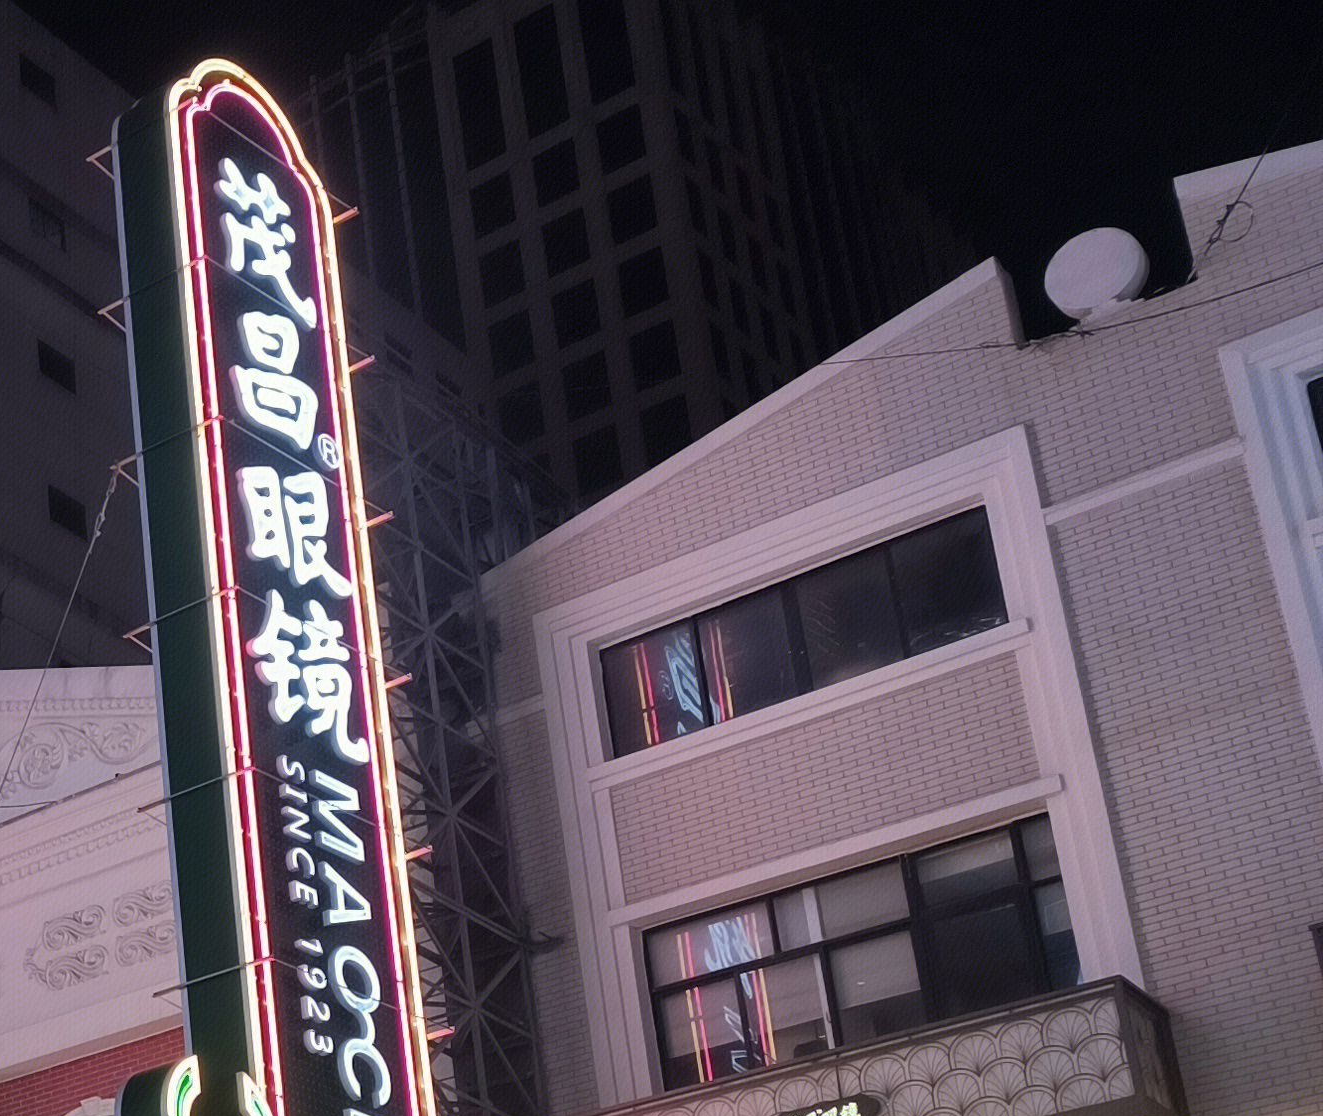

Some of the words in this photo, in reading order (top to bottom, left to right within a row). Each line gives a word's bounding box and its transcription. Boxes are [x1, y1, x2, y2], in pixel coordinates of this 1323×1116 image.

[212, 156, 369, 764] 茂昌眼镜
[276, 755, 318, 909] SINCE
[295, 938, 335, 1057] 1923
